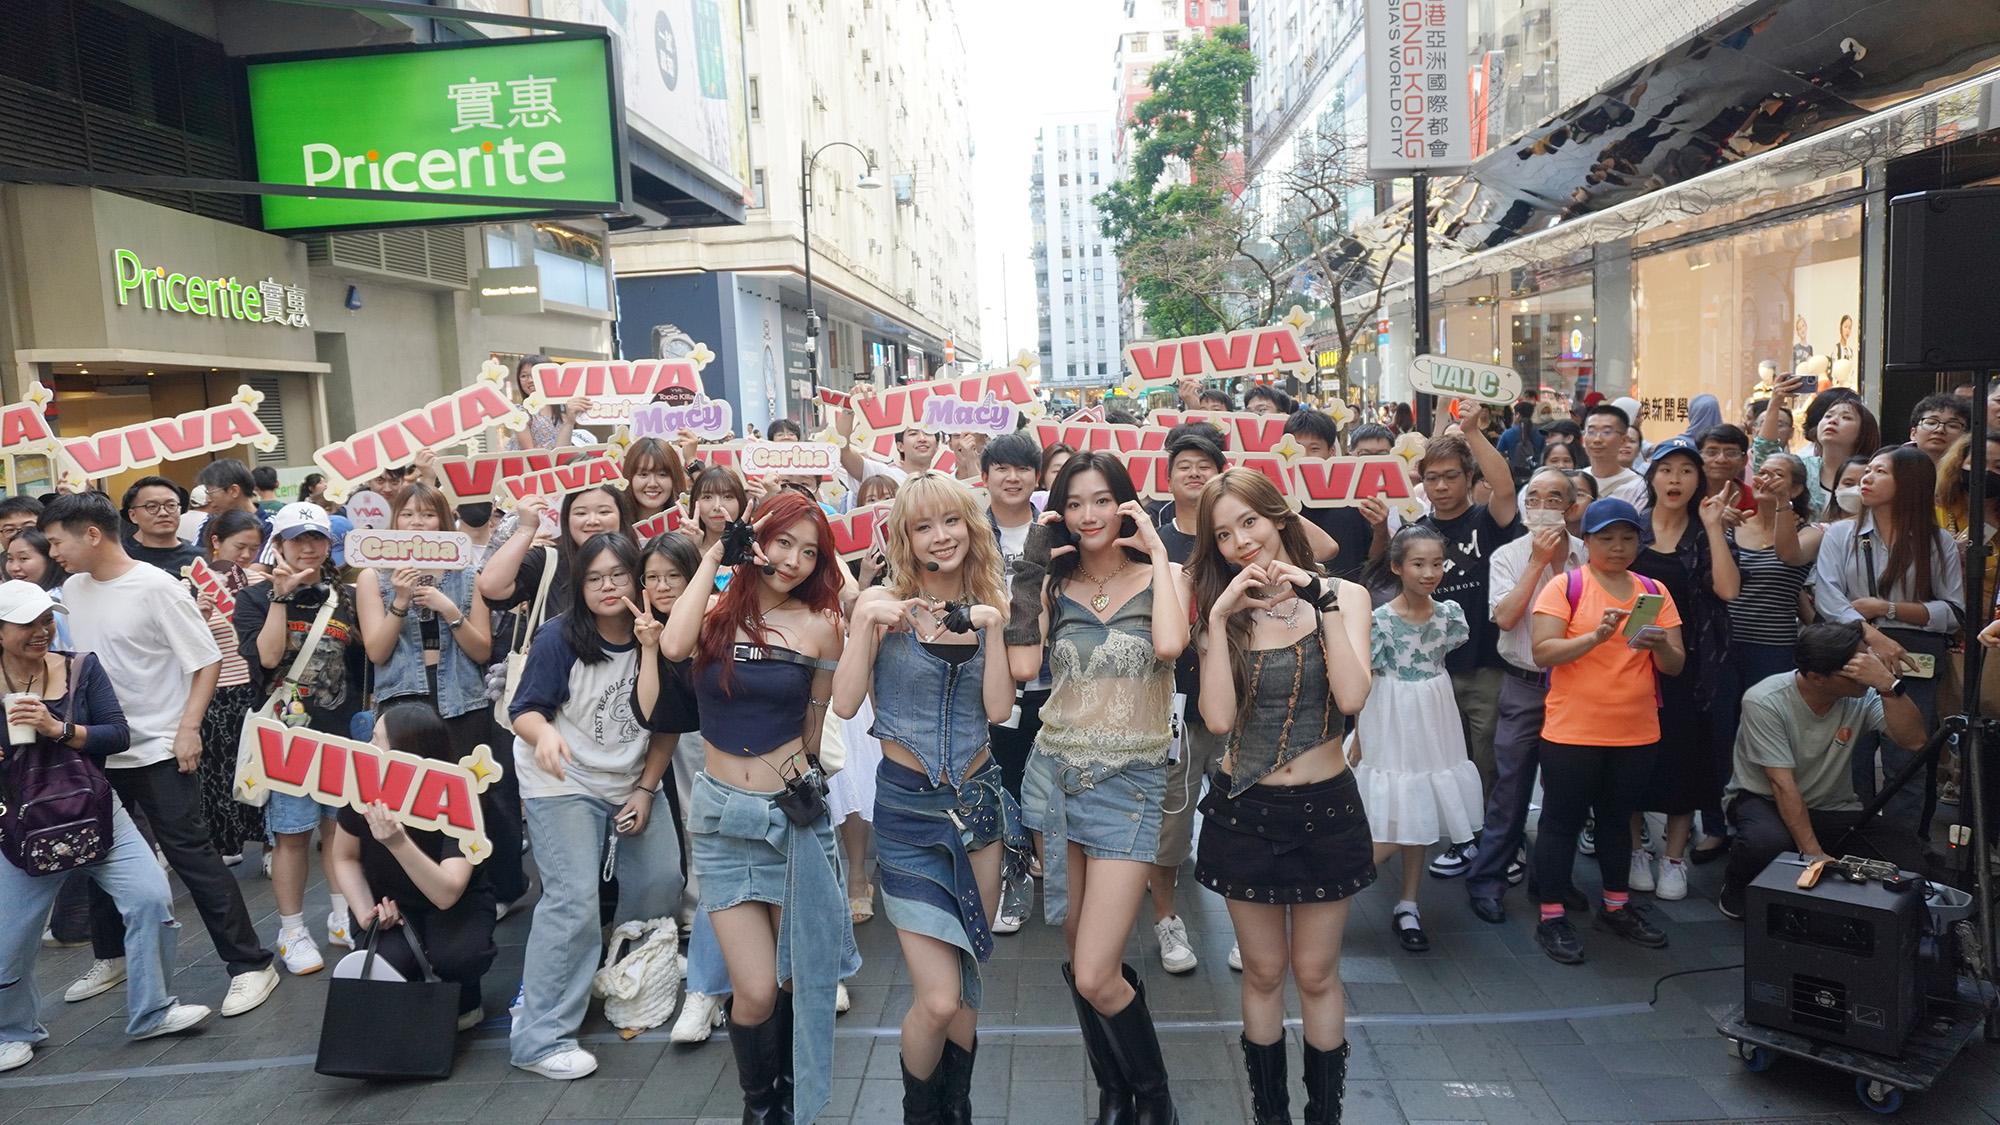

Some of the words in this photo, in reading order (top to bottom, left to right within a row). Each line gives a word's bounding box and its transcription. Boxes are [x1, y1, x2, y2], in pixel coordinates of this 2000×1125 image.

[447, 74, 562, 133] 實惠
[1388, 45, 1402, 112] WORLD
[1425, 0, 1449, 158] 港亞洲國際都會
[1390, 115, 1403, 159] CITY
[1403, 73, 1425, 159] KONG
[303, 137, 566, 199] Pricerite
[114, 249, 262, 322] Pricerite
[259, 277, 310, 327] 實惠
[539, 363, 698, 397] VIVA
[1131, 330, 1302, 380] VIVA
[1431, 361, 1476, 394] VAL
[1479, 370, 1500, 397] C
[322, 386, 511, 480] VIVA
[633, 403, 722, 437] Macy
[925, 399, 1010, 430] Macy
[64, 407, 261, 473] VIVA
[752, 446, 829, 468] Carina
[505, 460, 619, 500] VIVA
[1298, 462, 1410, 500] VA
[360, 535, 460, 562] Carina
[597, 678, 626, 711] BEAGLE
[257, 726, 475, 830] VIVA
